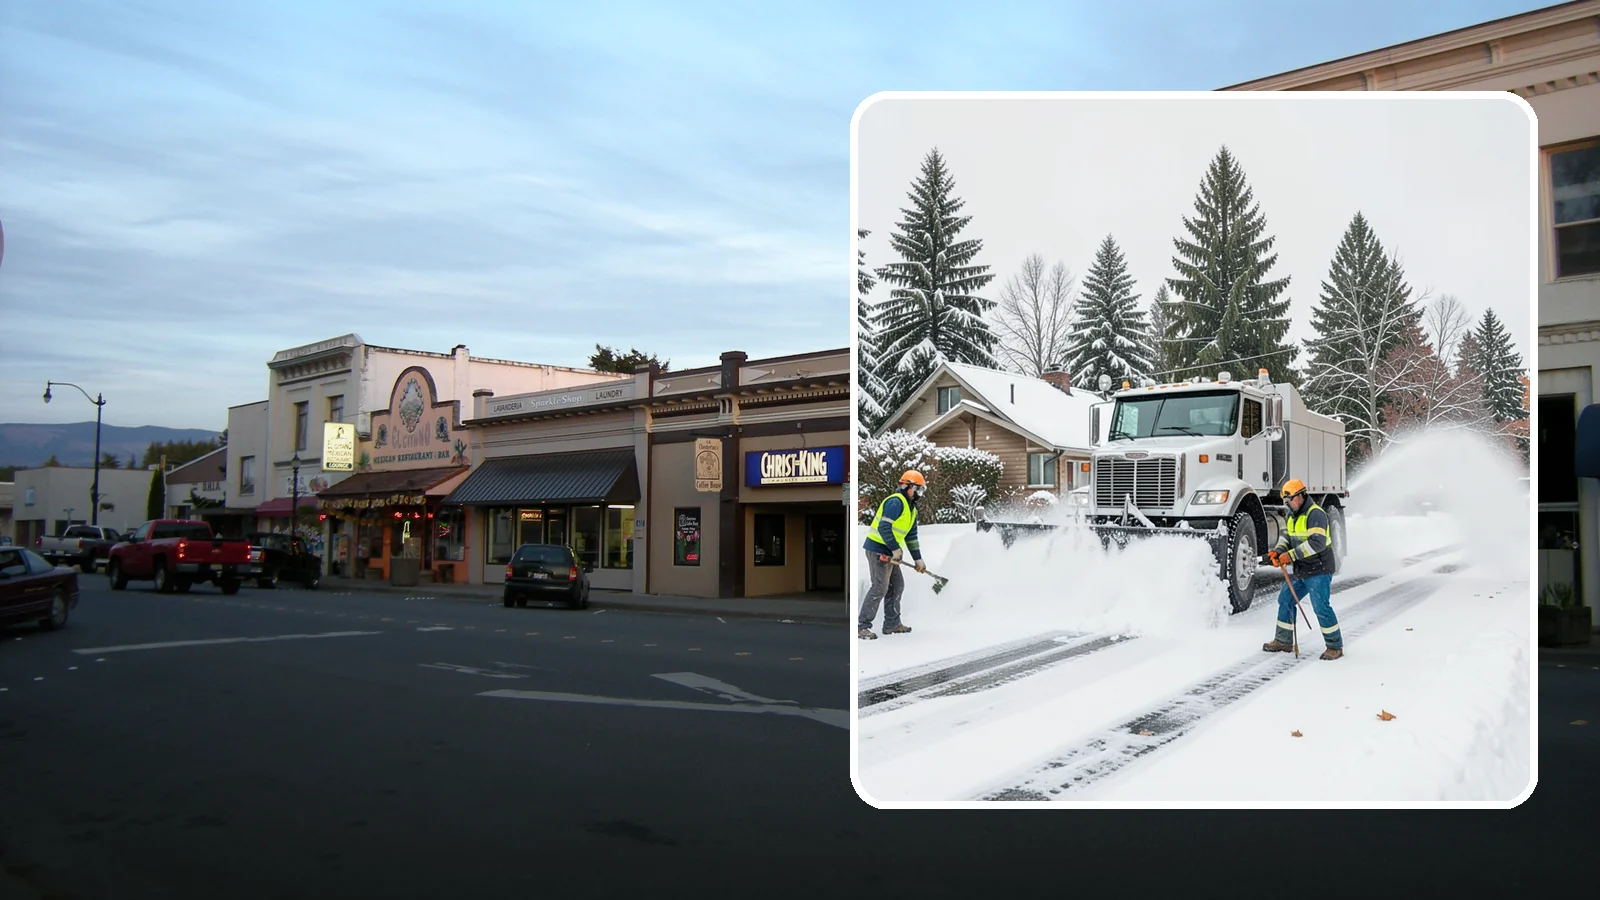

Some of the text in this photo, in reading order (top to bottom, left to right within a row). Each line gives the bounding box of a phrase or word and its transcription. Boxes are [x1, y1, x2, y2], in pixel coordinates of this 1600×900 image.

[595, 388, 623, 400] LAUNDRY
[493, 402, 523, 412] LAVANDERIA
[530, 394, 582, 409] Sparkle Shop
[373, 455, 396, 464] MEXICAN
[397, 451, 433, 463] RESTAURANT
[438, 450, 450, 459] BAR
[761, 450, 827, 477] CHRIST KING
